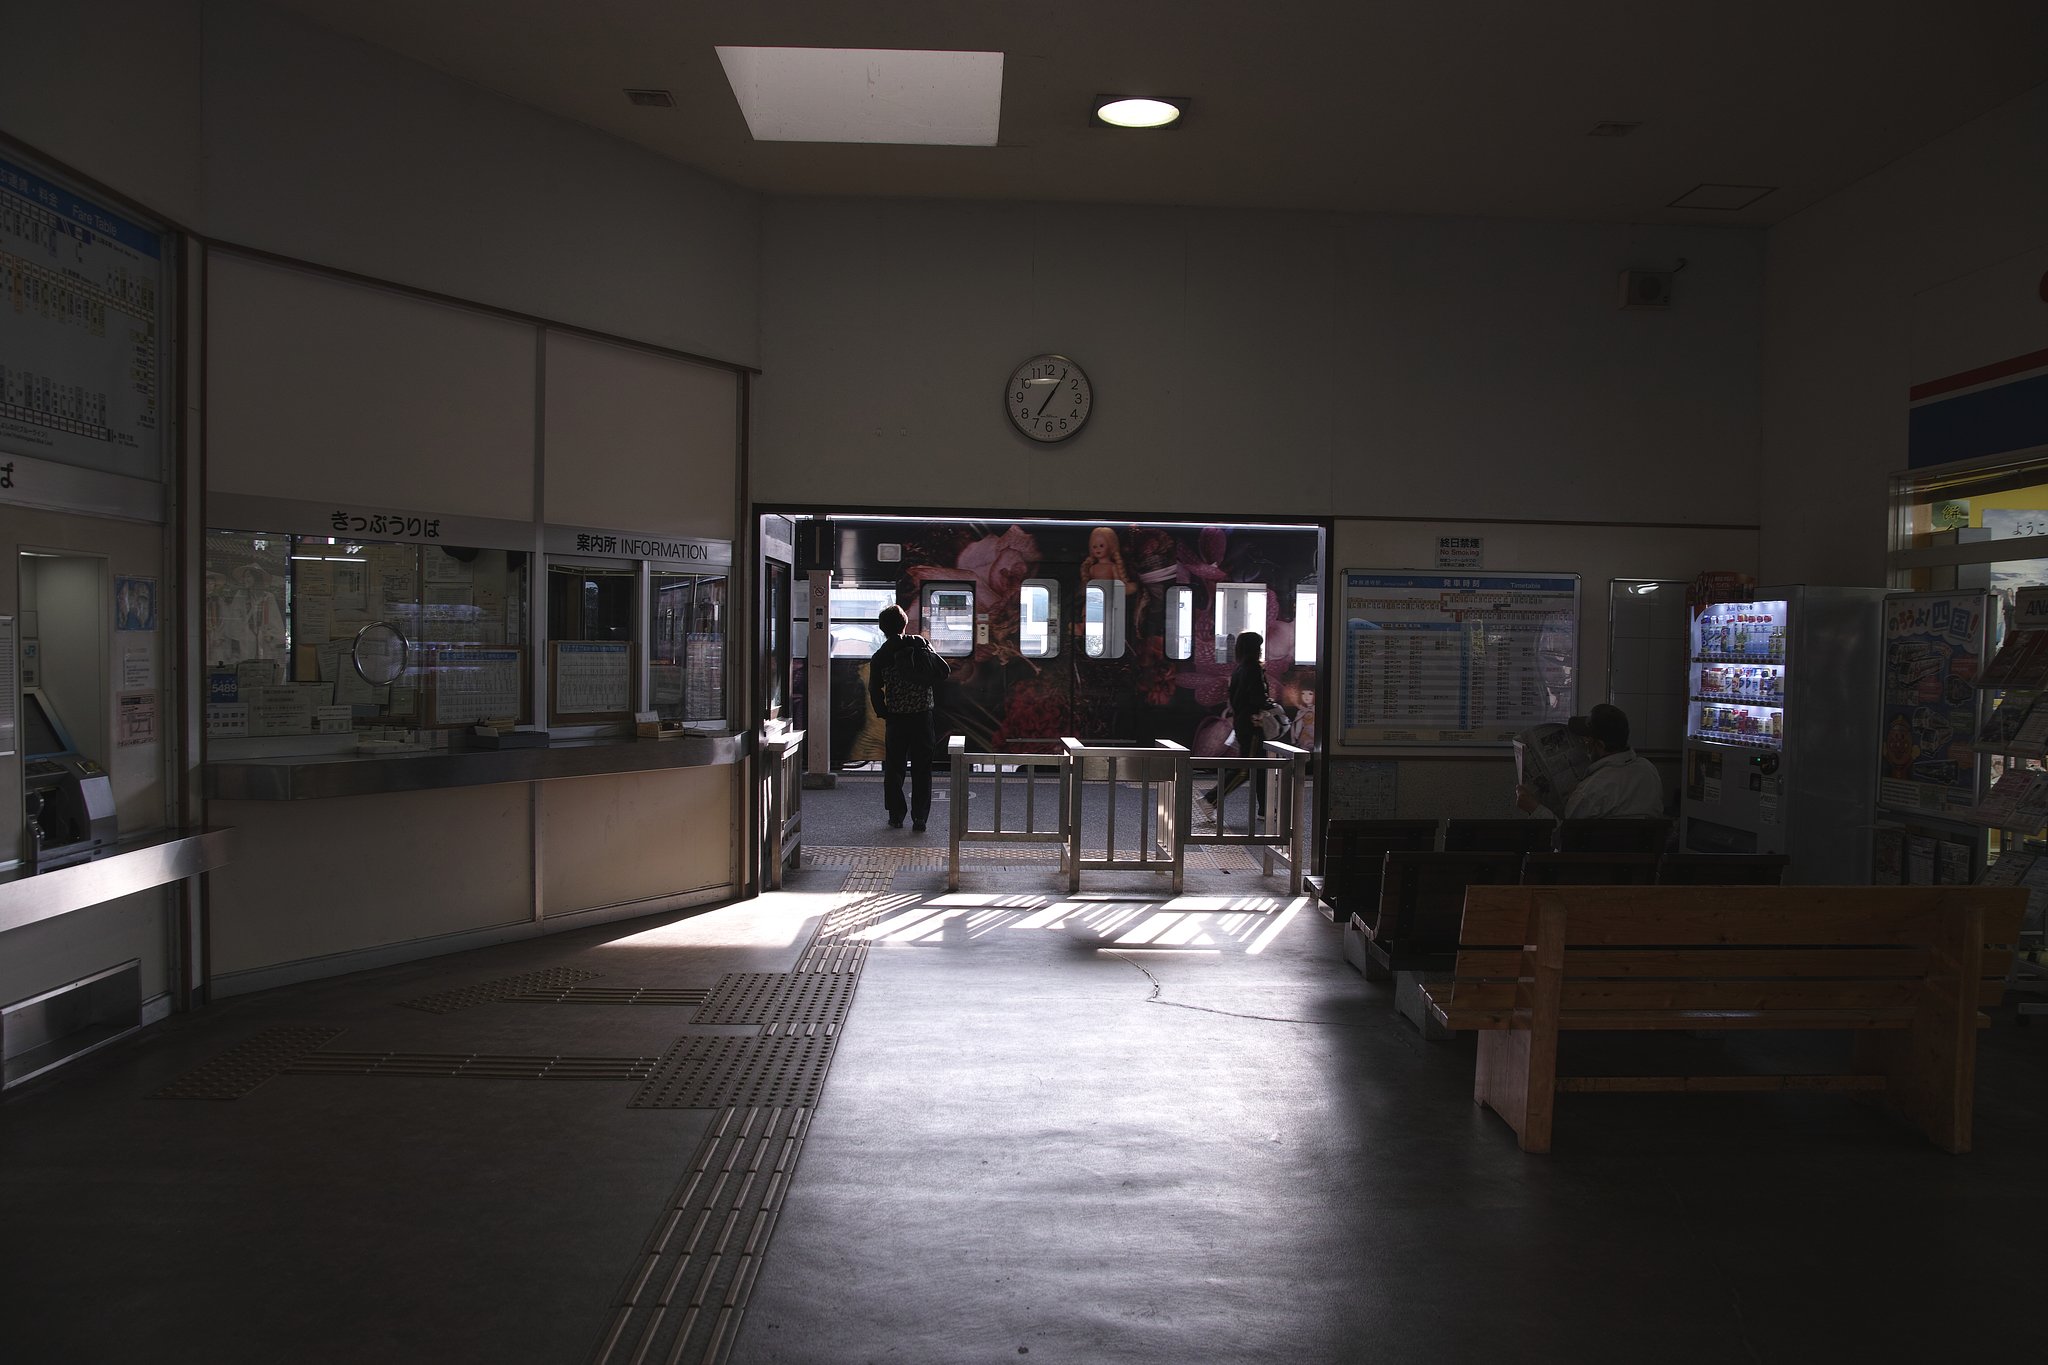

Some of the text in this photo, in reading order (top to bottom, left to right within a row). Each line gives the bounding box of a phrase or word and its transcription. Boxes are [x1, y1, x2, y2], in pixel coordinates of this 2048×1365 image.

[72, 204, 118, 237] Fare Table
[1044, 364, 1055, 376] 12
[1021, 378, 1032, 389] 10
[1071, 378, 1079, 390] 2
[1016, 392, 1024, 403] 9
[1074, 393, 1082, 404] 3
[1021, 408, 1029, 419] 8
[1070, 408, 1079, 420] 4
[1032, 417, 1040, 429] 7
[1045, 421, 1053, 432] 6
[1059, 418, 1067, 430] 5
[576, 533, 708, 561] 案内所 INFORMATION
[1440, 537, 1480, 549] 終日禁煙
[1452, 549, 1480, 557] Smoking
[1442, 579, 1480, 588] 発車時刻
[815, 608, 824, 630] 禁煙
[212, 683, 237, 693] 5489
